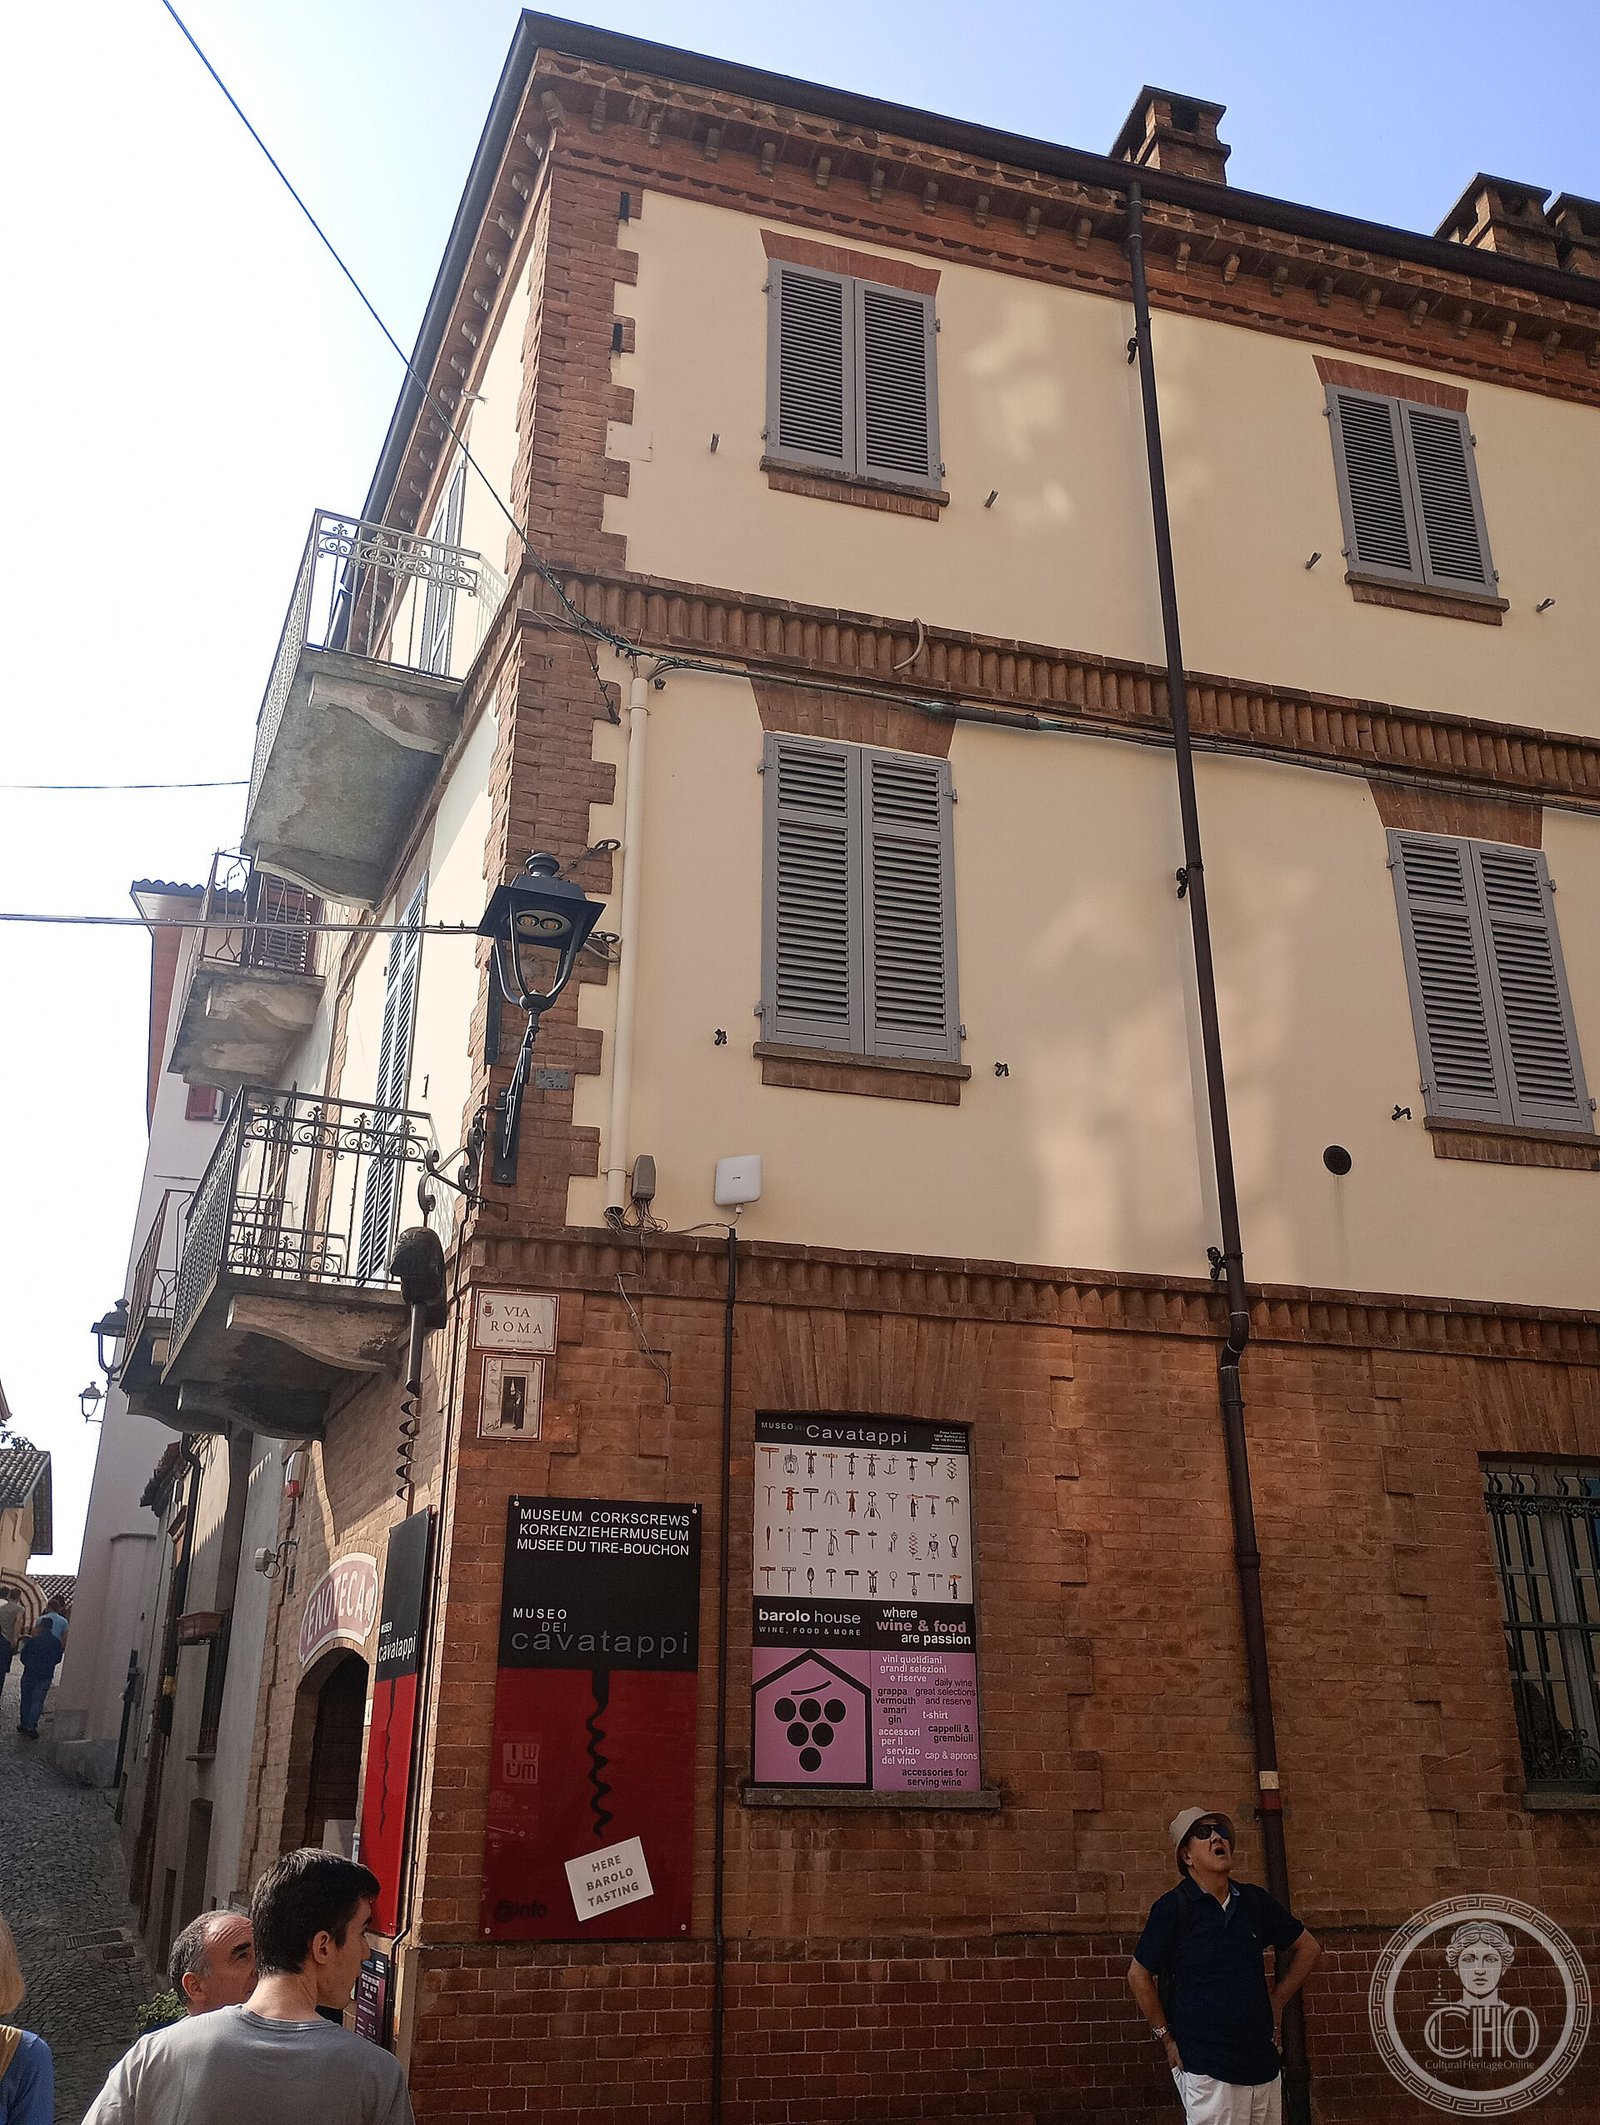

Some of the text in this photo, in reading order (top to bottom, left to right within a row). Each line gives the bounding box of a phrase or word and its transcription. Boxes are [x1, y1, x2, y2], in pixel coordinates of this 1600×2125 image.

[504, 1306, 530, 1318] VIA
[490, 1320, 543, 1334] ROMA
[761, 1422, 794, 1430] MUSEO
[806, 1424, 908, 1446] Cavatappi
[520, 1508, 690, 1527] MUSEUM CORKSCREWS
[519, 1523, 689, 1541] KORKENZIEHERMUSEUM
[517, 1538, 690, 1556] MUSEE DU TIRE-BOUCHON
[306, 1570, 366, 1647] ENOTECA
[882, 1606, 918, 1619] where
[512, 1608, 568, 1620] MUSEO
[759, 1608, 861, 1624] barolo house
[541, 1621, 567, 1632] DEI
[759, 1626, 789, 1635] WINE,
[793, 1627, 820, 1635] FOOD
[834, 1628, 861, 1636] MORE
[876, 1619, 967, 1633] wine & food
[511, 1630, 688, 1659] cavatappi
[901, 1633, 971, 1647] are passion
[378, 1630, 417, 1663] cavatappi
[882, 1655, 943, 1664] vini quotidiani
[880, 1664, 947, 1674] grandi selezioni
[898, 1674, 927, 1682] riserve
[935, 1678, 973, 1688] daily wine
[878, 1688, 908, 1697] grappa
[915, 1688, 976, 1697] great selections
[875, 1697, 916, 1705] vermouth
[925, 1697, 940, 1705] and
[883, 1706, 907, 1714] amari
[922, 1710, 949, 1720] t-shirt
[888, 1715, 902, 1725] gin
[878, 1727, 920, 1736] accessori
[928, 1724, 970, 1734] cappelli &
[881, 1737, 903, 1747] per il
[933, 1734, 974, 1744] grembiuli
[886, 1746, 921, 1755] servizio
[881, 1756, 917, 1765] del vino
[925, 1751, 978, 1761] cap & aprons
[902, 1768, 968, 1777] accessories for
[907, 1777, 962, 1788] serving wine
[591, 1855, 622, 1873] HERE
[586, 1867, 634, 1892] BAROLO
[587, 1881, 640, 1907] TASTING
